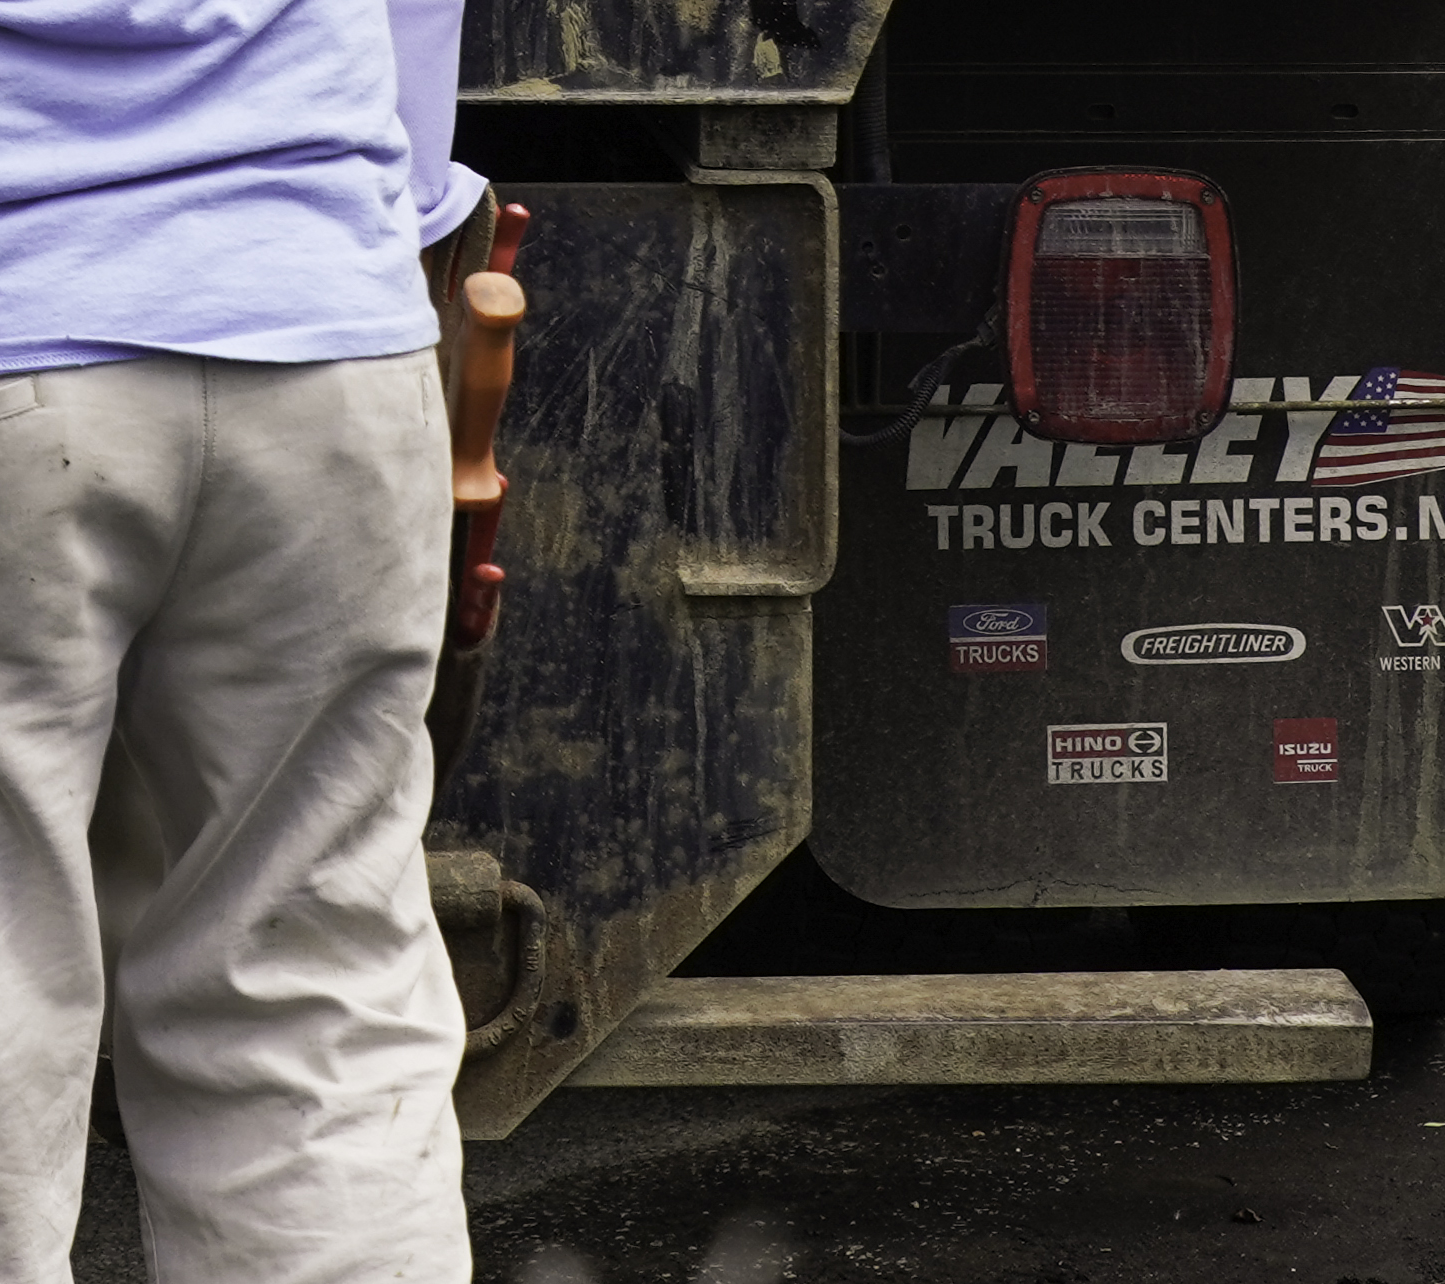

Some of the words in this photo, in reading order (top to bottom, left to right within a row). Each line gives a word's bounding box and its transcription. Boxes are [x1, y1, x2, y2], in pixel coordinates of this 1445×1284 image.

[924, 501, 1113, 551] TRUCK
[975, 612, 1021, 632] Ford
[955, 644, 1040, 665] TRUCKS
[1140, 634, 1287, 655] FREIGHTLINER
[1379, 655, 1441, 671] WESTERN
[1055, 735, 1123, 753] HINO
[1279, 743, 1332, 756] ISUZU
[1051, 759, 1164, 780] TRUCKS
[1297, 763, 1333, 773] TRUCK
